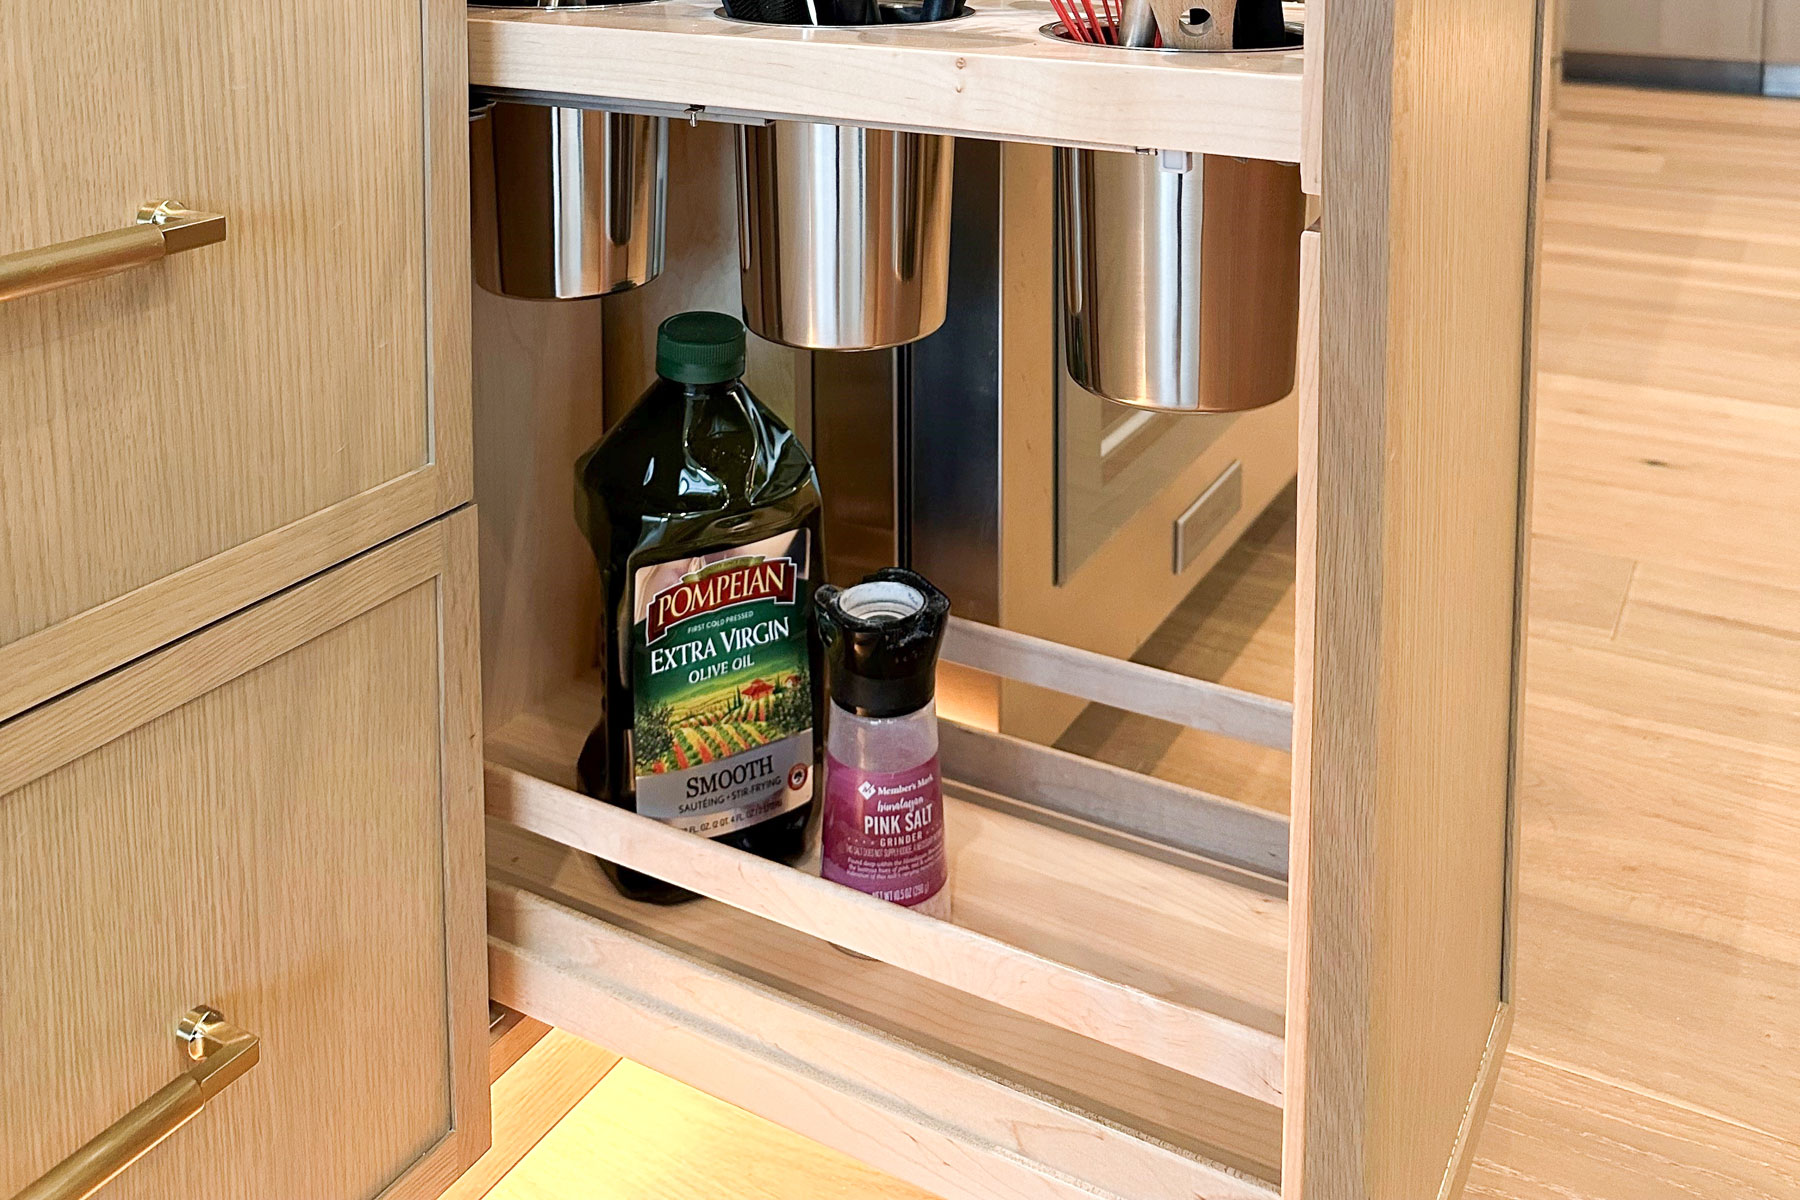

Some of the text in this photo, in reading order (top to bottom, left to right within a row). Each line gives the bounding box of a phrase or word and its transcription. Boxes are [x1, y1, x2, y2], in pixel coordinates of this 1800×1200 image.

[656, 562, 786, 627] POMPEIAN
[687, 610, 754, 634] FIRST COLD PRESSED
[651, 616, 790, 675] EXTRA VIRGIN
[688, 654, 755, 684] OLIVE OIL
[686, 754, 774, 799] SMOOTH
[864, 803, 933, 835] PINK SALT
[880, 831, 923, 847] GRINDER
